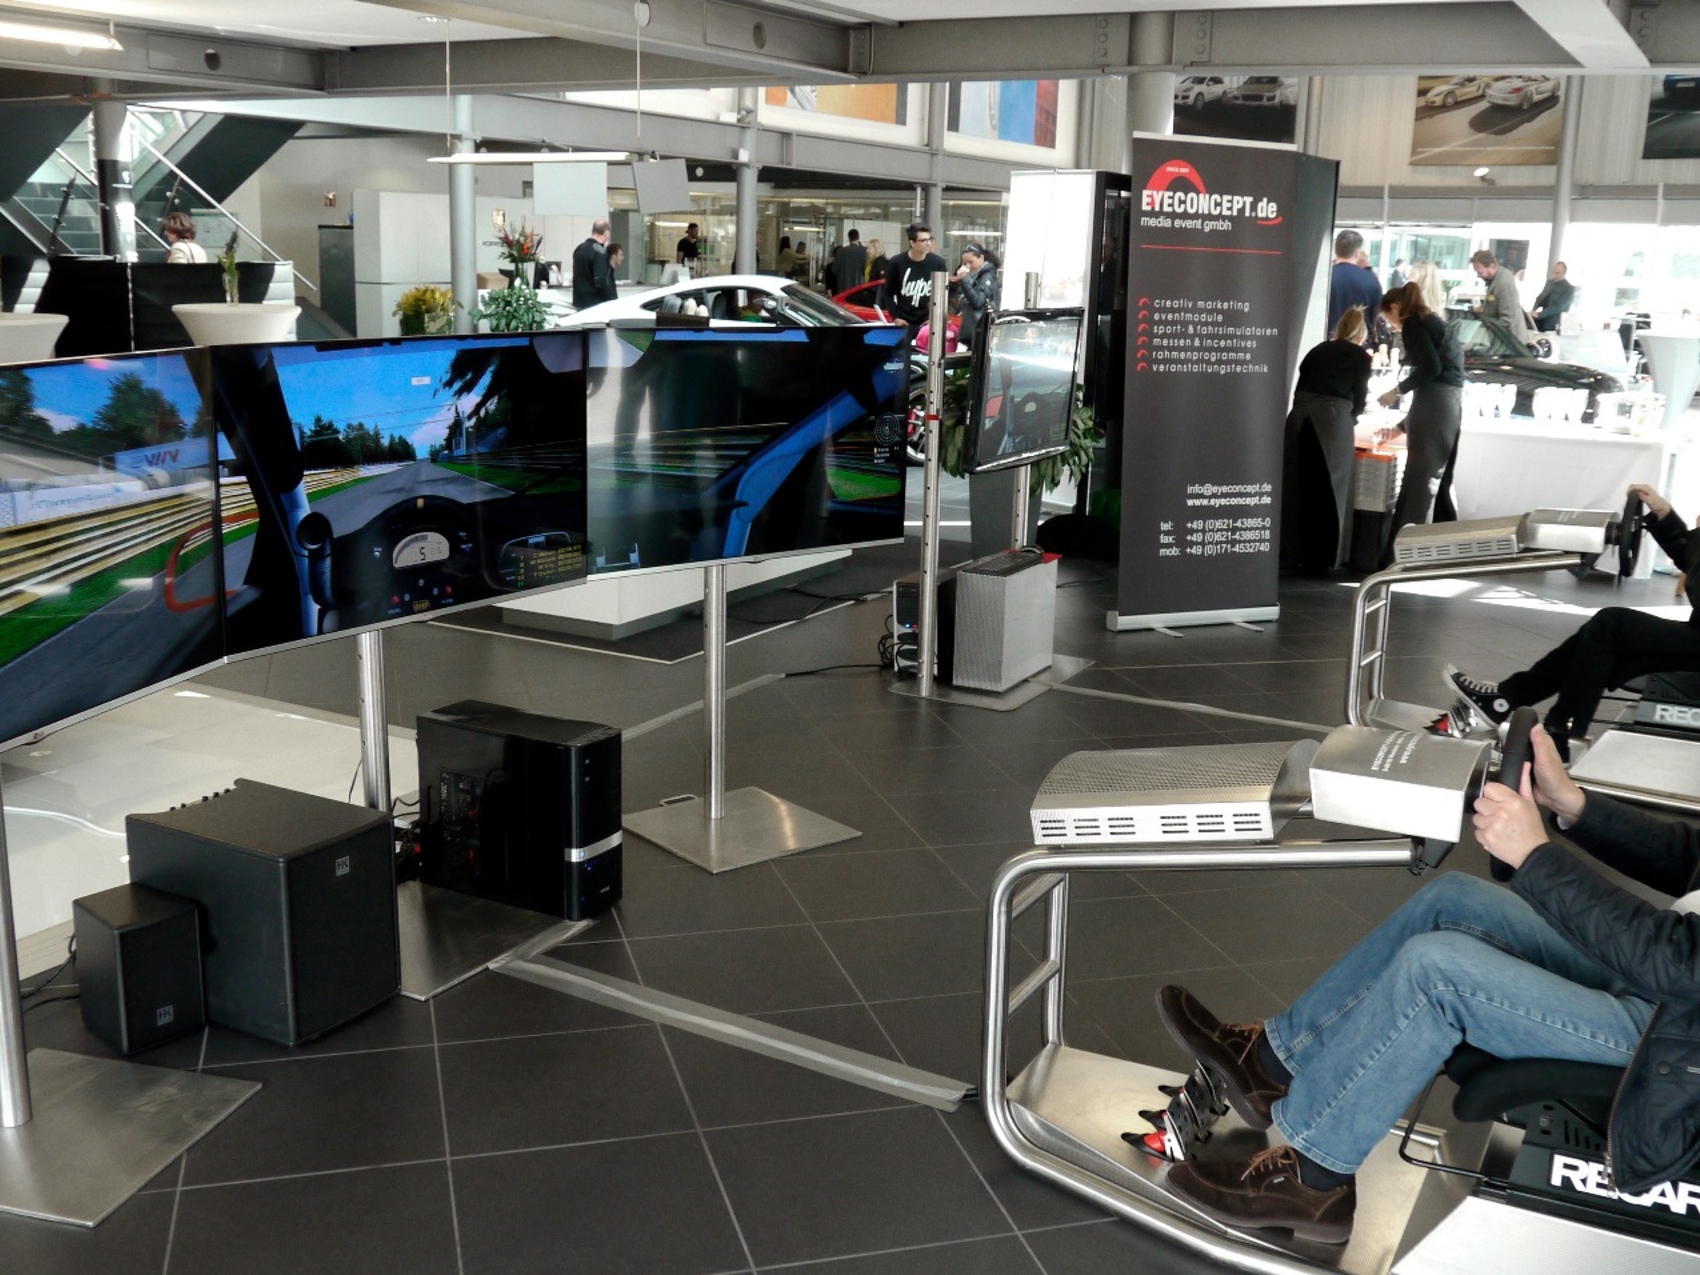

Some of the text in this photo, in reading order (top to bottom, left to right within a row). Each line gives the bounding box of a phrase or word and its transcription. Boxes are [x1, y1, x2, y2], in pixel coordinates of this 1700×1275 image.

[1141, 189, 1278, 218] EYECONCEPT.de
[1140, 215, 1232, 233] media event gmbh
[900, 267, 932, 308] hype
[1153, 298, 1250, 312] creativ marketing
[1153, 311, 1223, 322] eventmodule
[1152, 323, 1279, 336] sport- & fahrsimulatoren
[1152, 337, 1257, 348] messen & incentives
[1152, 350, 1252, 362] rahmenprogramme
[1151, 363, 1269, 374] veranstaltungstechnik
[1187, 482, 1273, 496] info@eyeconcept.de
[1186, 495, 1272, 508] www.eyeconcept.de
[1160, 521, 1174, 531] tel:
[1186, 519, 1203, 531] +49
[1186, 532, 1203, 543] +49
[1185, 545, 1203, 556] +49
[1204, 542, 1270, 557] (0)171-4532740
